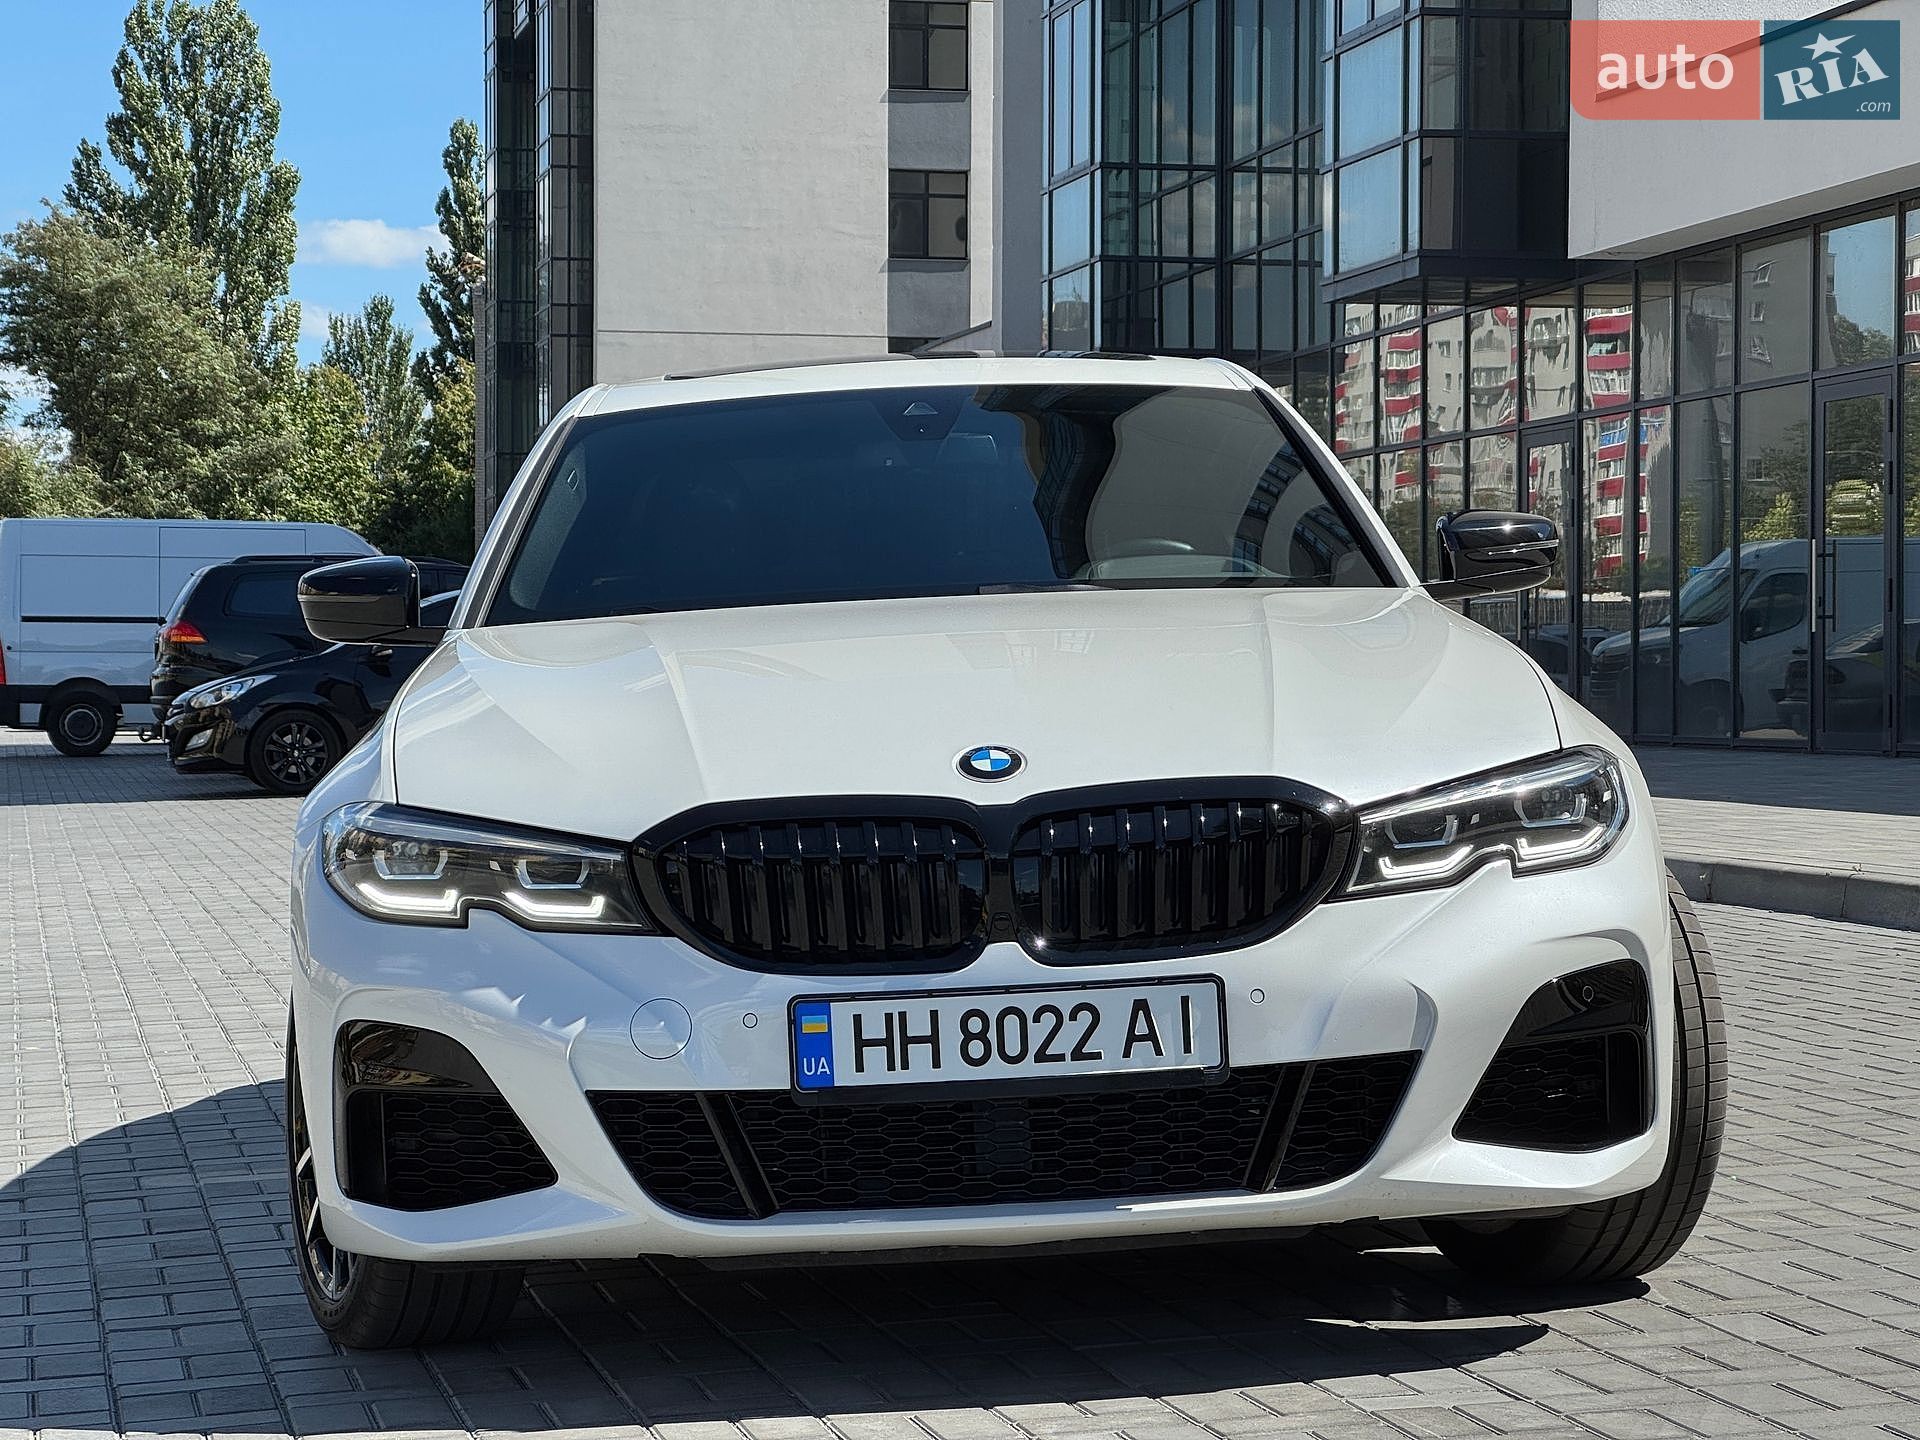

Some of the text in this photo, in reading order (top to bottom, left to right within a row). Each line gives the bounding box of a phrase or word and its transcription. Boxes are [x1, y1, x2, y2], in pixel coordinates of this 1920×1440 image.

[852, 1009, 942, 1073] HH
[959, 1001, 1104, 1067] 8022
[803, 1056, 830, 1077] UA
